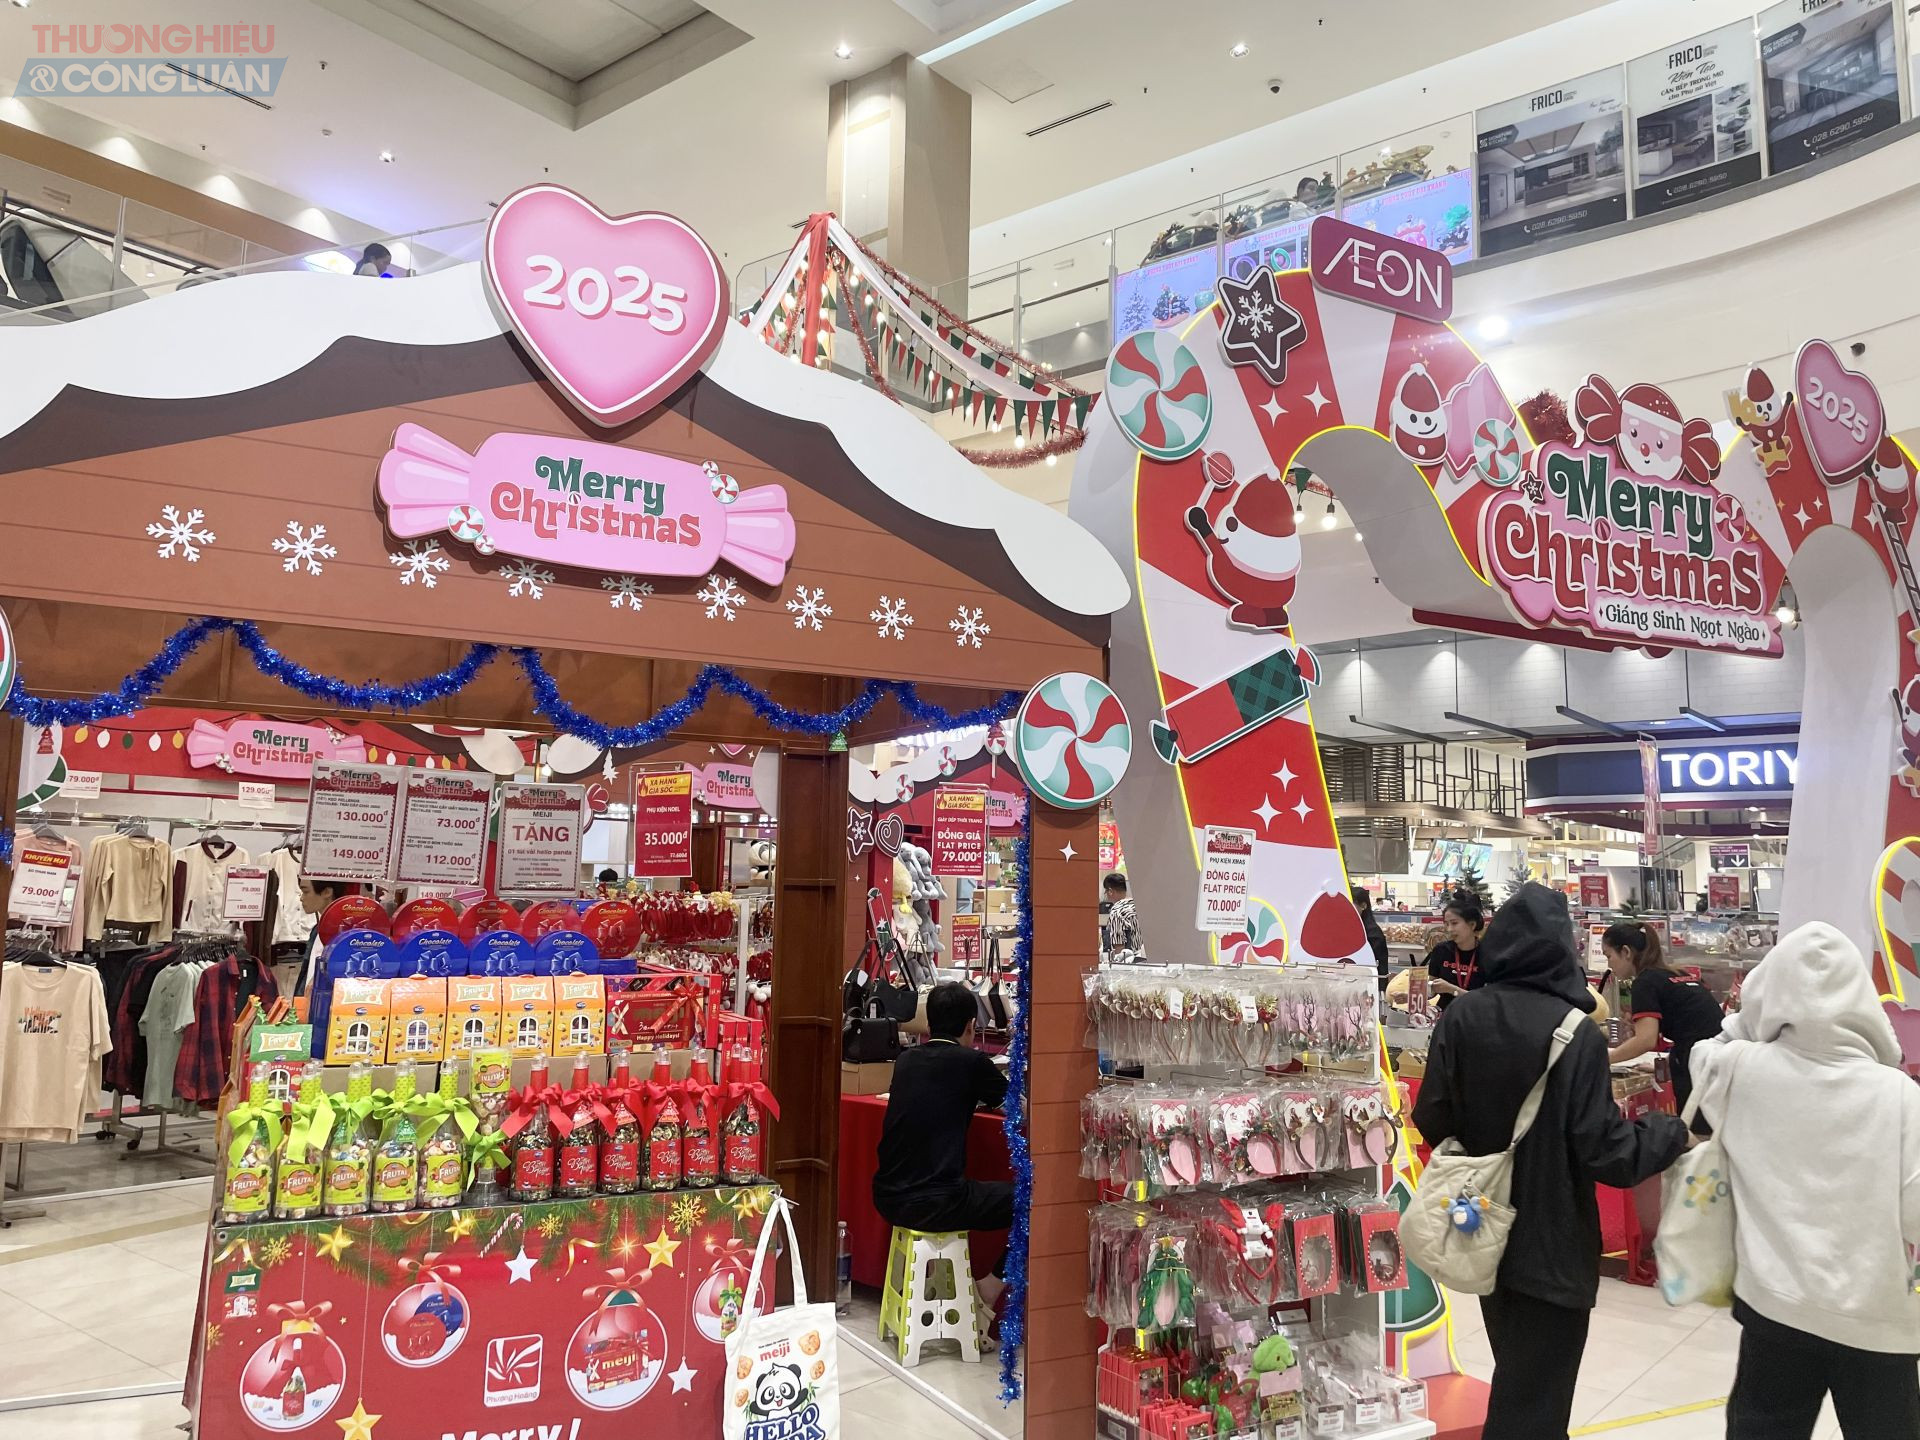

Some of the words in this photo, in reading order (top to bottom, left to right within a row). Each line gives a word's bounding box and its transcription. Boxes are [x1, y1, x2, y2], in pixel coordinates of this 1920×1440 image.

[1669, 44, 1702, 69] FRICO
[1531, 89, 1563, 112] FRICO
[523, 254, 687, 334] 2025
[1804, 376, 1869, 443] 2025
[534, 455, 666, 517] Merry
[1547, 452, 1714, 559] Merry
[490, 481, 702, 547] Christmas
[1496, 501, 1763, 612] Christmas
[1605, 604, 1649, 630] Giáng
[1653, 609, 1686, 631] Sinh
[1690, 616, 1724, 640] Ngọt
[1727, 620, 1760, 642] Ngào
[253, 729, 309, 753] Merry
[233, 741, 324, 766] Christmas
[341, 769, 373, 781] Merry
[717, 769, 751, 787] Merry
[331, 777, 381, 789] Christmas
[434, 777, 465, 788] Merry
[706, 780, 754, 798] Christma
[425, 784, 474, 796] Christmas
[530, 789, 558, 799] Merry
[336, 810, 388, 823] 130.000đ
[437, 817, 480, 829] 73.000đ
[512, 822, 570, 845] TẶNG
[645, 831, 688, 846] 35.000đ
[937, 827, 964, 840] ĐỒNG
[966, 830, 981, 840] GIÁ
[332, 847, 384, 860] 149.000đ
[426, 853, 476, 866] 112.000đ
[942, 851, 981, 862] 79.000đ
[1206, 869, 1230, 881] ĐỒNG
[1232, 871, 1246, 881] GIÁ
[1203, 884, 1222, 893] FLAT
[1224, 885, 1246, 894] PRICE
[341, 904, 375, 913] Chocolate
[412, 905, 445, 913] Chocolate
[1207, 899, 1241, 912] 70.000đ
[350, 938, 384, 947] Chocolate
[419, 938, 452, 946] Chocolate
[488, 938, 520, 946] Chocolate
[552, 938, 585, 946] Chocolate
[1411, 994, 1424, 1014] 50
[760, 1342, 790, 1361] meiji
[602, 1351, 635, 1369] meiji
[745, 1406, 816, 1440] HELLO
